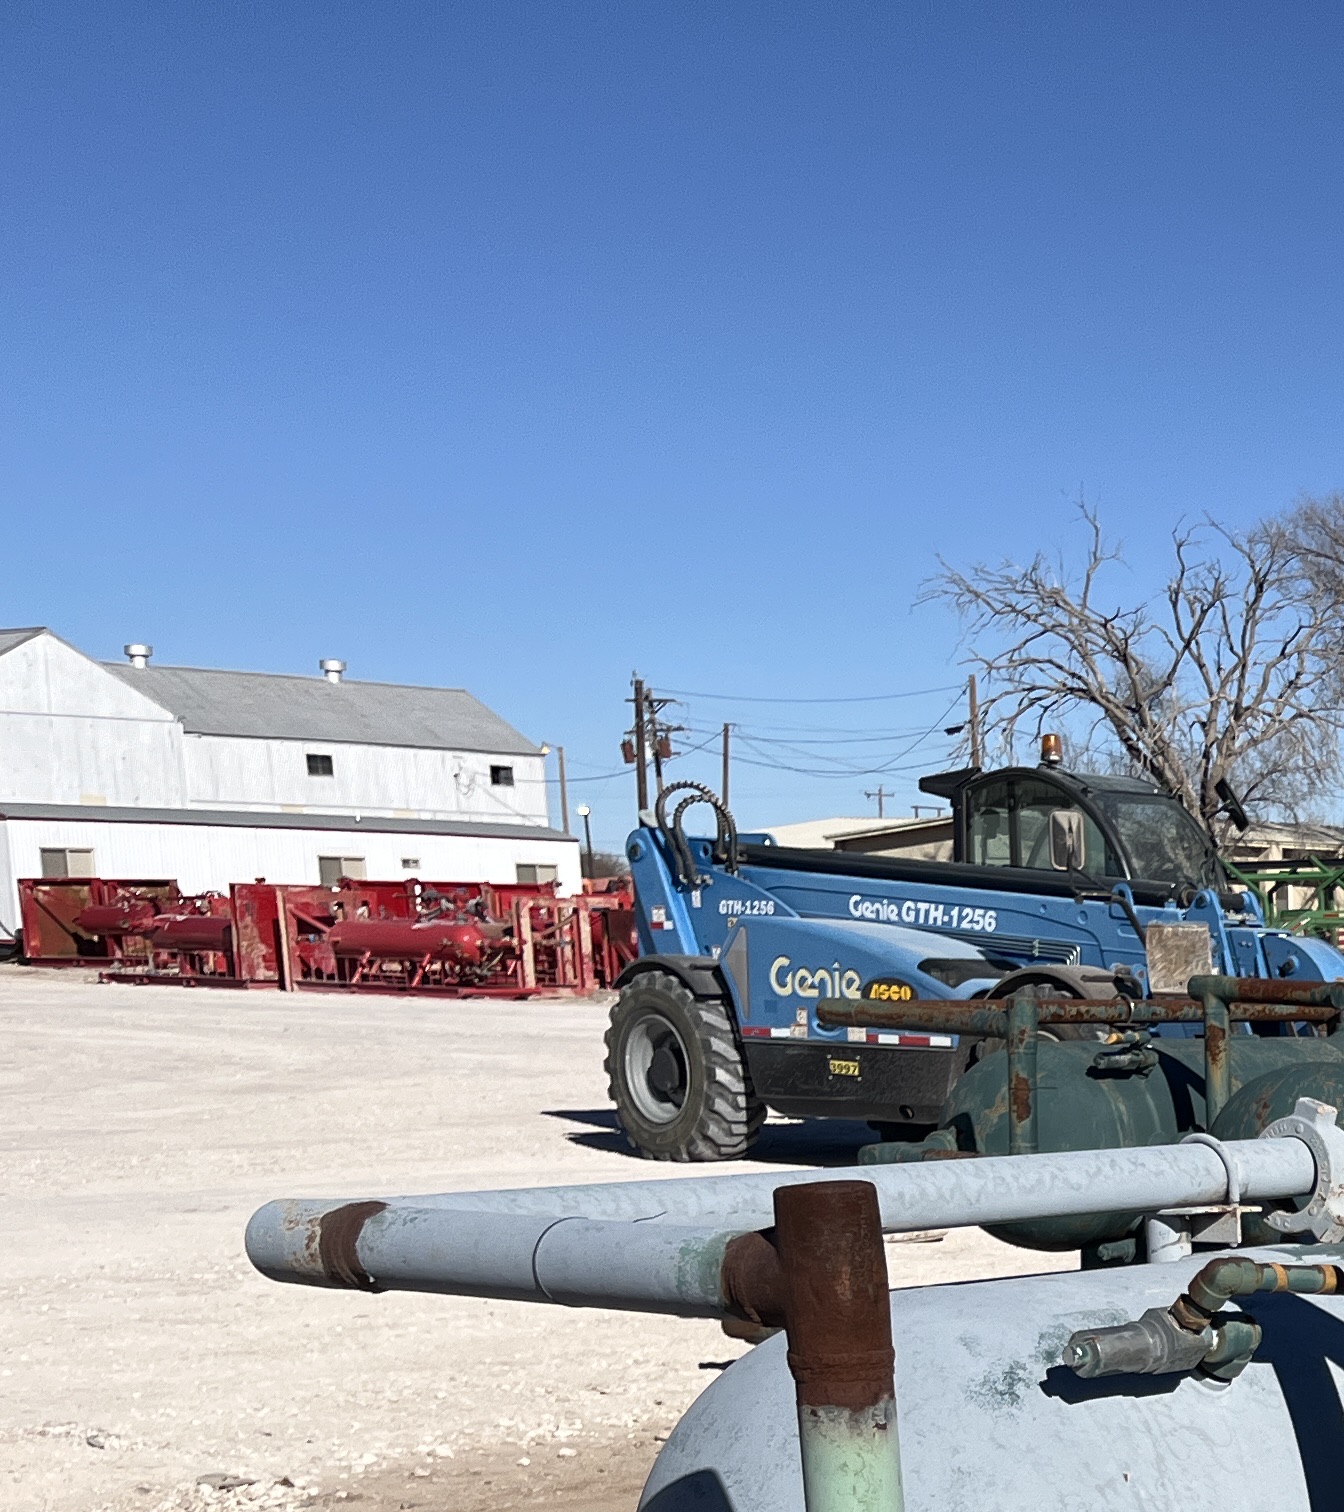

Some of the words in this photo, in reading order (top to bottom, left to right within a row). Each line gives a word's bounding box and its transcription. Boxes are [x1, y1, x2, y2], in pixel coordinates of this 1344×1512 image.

[718, 899, 775, 916] GTH-1256
[848, 894, 899, 923] Genie
[901, 900, 997, 933] GTH-1256
[769, 955, 862, 999] Genie
